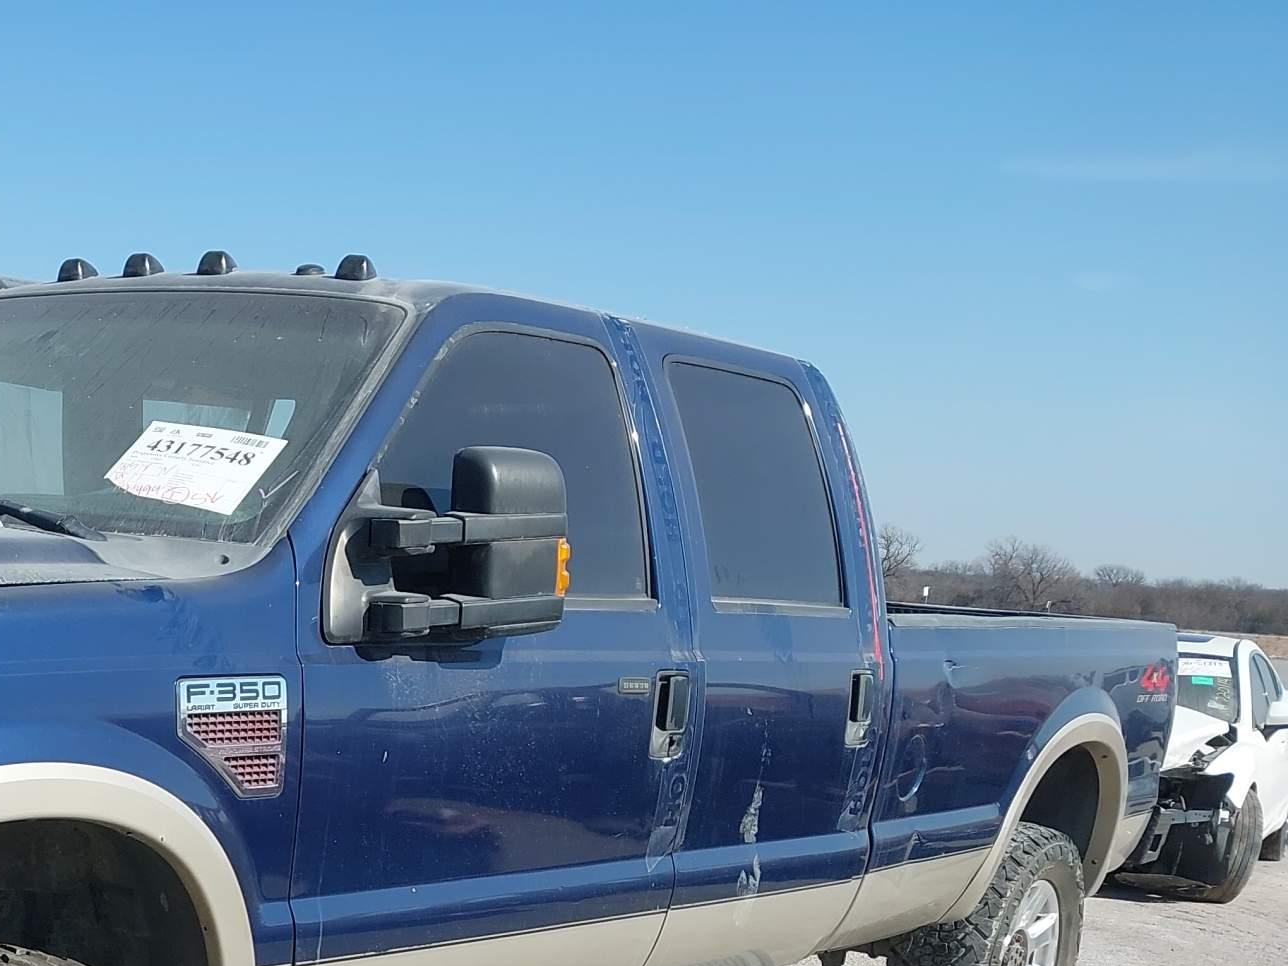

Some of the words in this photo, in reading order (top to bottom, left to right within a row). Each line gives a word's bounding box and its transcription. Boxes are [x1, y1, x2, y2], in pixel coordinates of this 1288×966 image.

[146, 438, 255, 466] 43177548
[186, 681, 281, 703] F-350
[1136, 694, 1150, 703] OFF
[1150, 694, 1168, 702] ROAD
[186, 704, 216, 712] LARIAT
[232, 702, 259, 710] SUPER
[260, 701, 281, 709] DUTY
